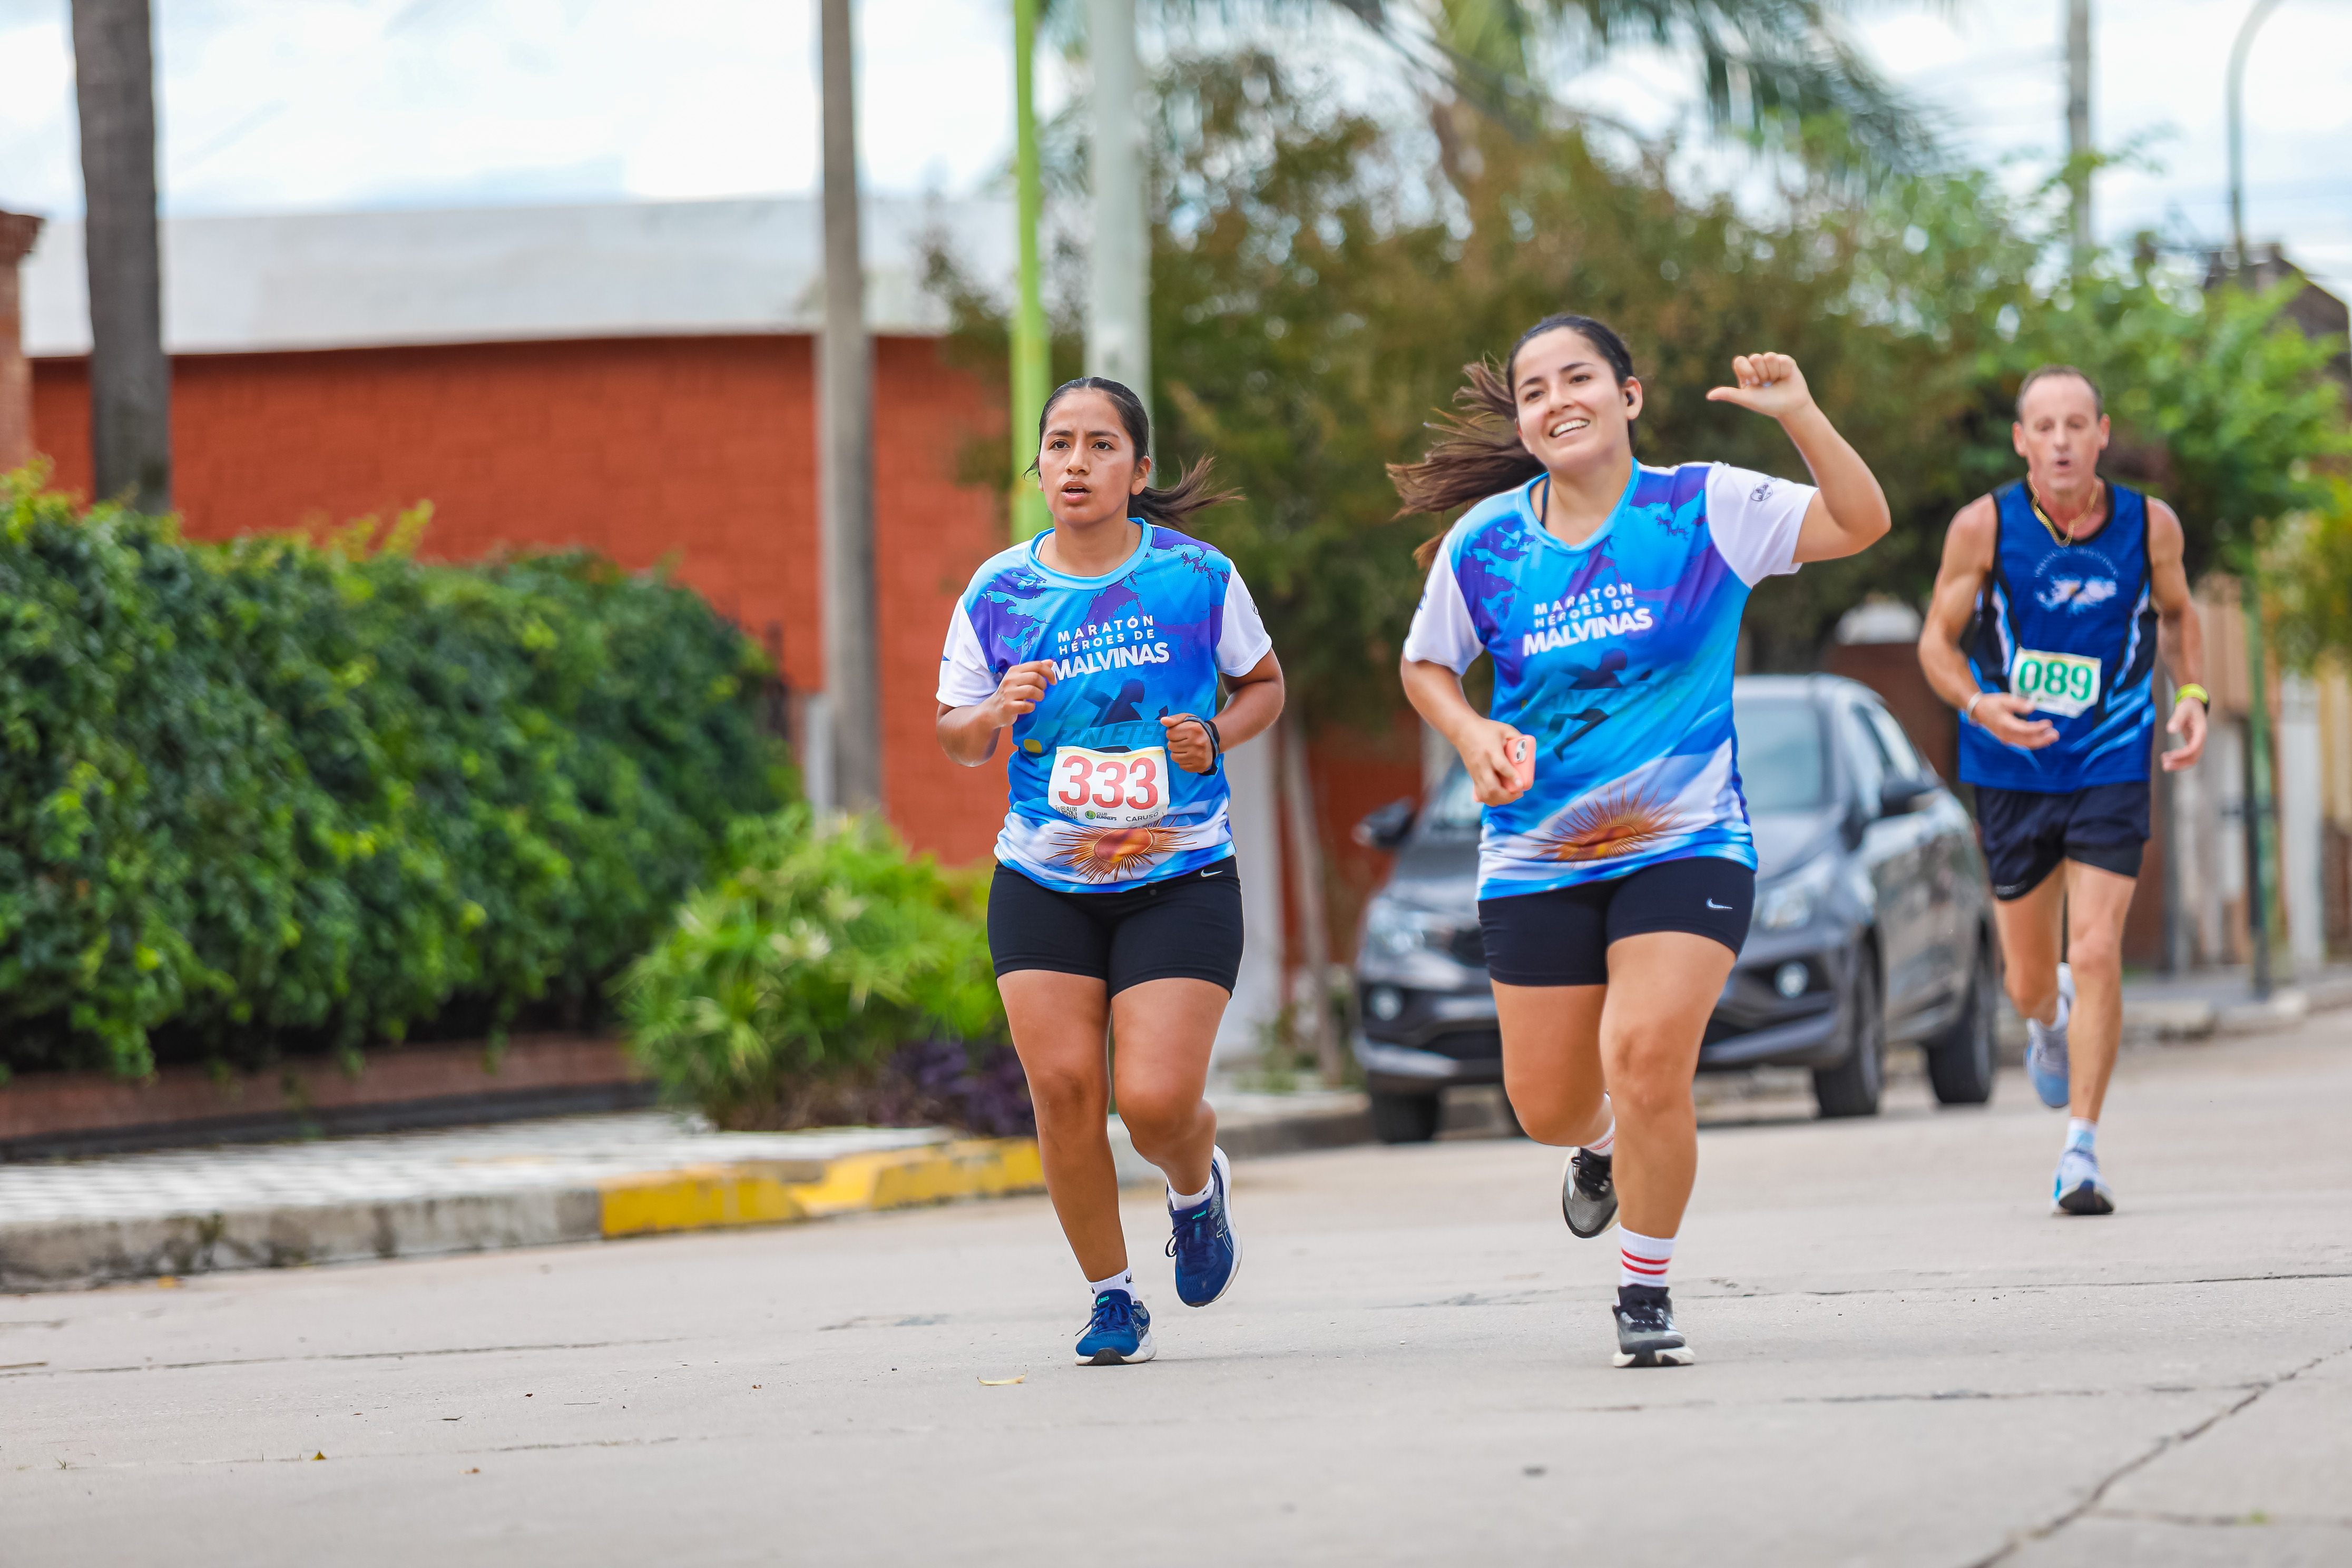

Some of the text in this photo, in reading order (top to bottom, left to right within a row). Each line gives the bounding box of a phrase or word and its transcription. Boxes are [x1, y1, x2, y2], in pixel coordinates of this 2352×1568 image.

[1534, 583, 1633, 615] MARATÓN
[1534, 597, 1634, 628] HÉROES DE
[1057, 615, 1154, 643] MARATÓN
[1059, 629, 1155, 655] HÉROES DE
[1523, 608, 1653, 656] MALVINAS
[1051, 642, 1170, 681] MALVINAS
[2018, 660, 2092, 701] 089
[1059, 755, 1158, 810] 333
[1125, 811, 1159, 822] CARUSO
